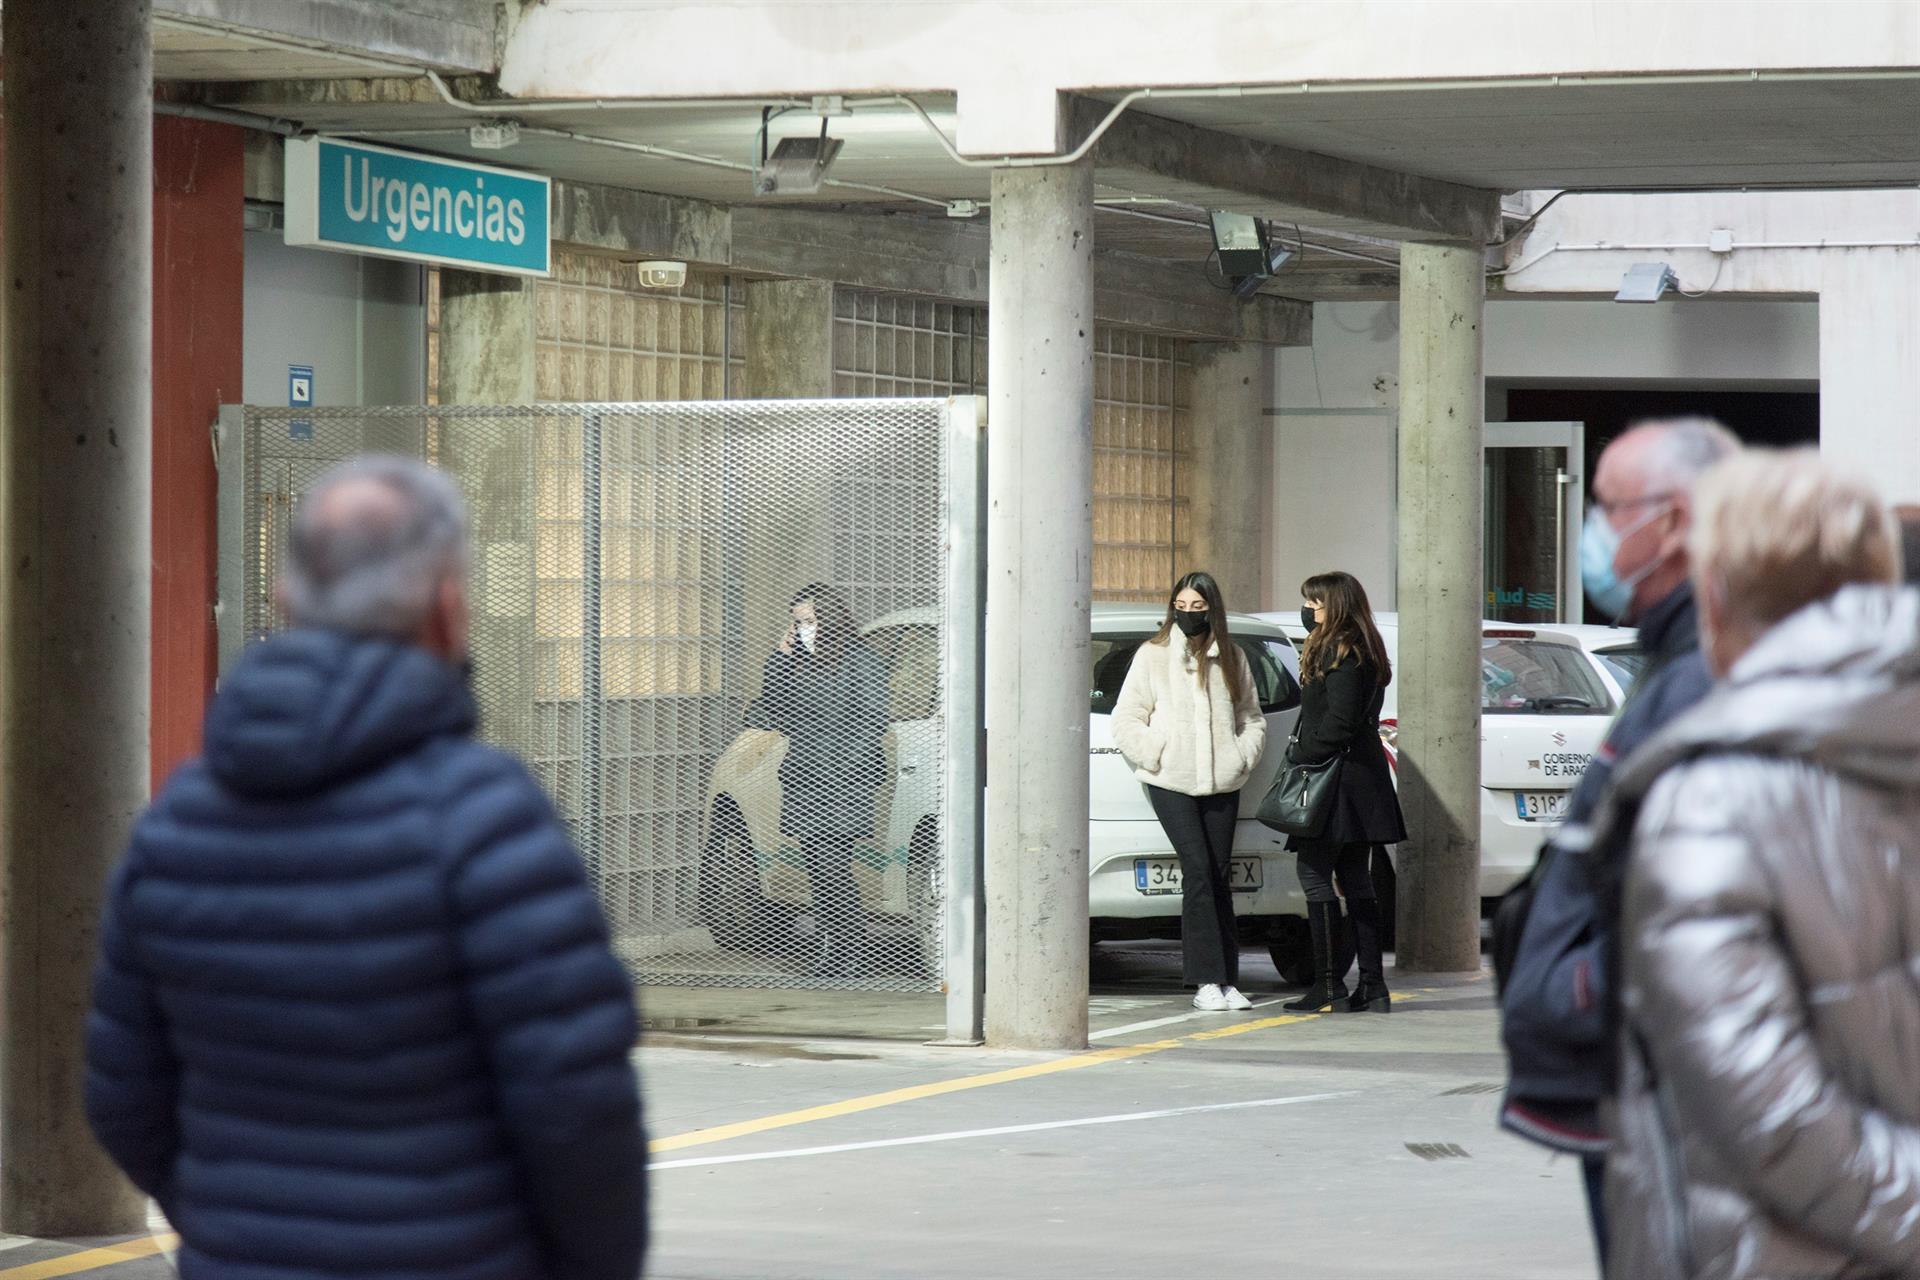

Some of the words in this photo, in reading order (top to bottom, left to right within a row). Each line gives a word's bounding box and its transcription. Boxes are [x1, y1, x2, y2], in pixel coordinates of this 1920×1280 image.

[344, 154, 526, 246] Urgencias
[1487, 585, 1524, 605] alud
[1543, 753, 1592, 764] GOBIERNO
[1544, 765, 1559, 776] DE
[1152, 863, 1179, 885] 34
[1230, 862, 1255, 883] FX
